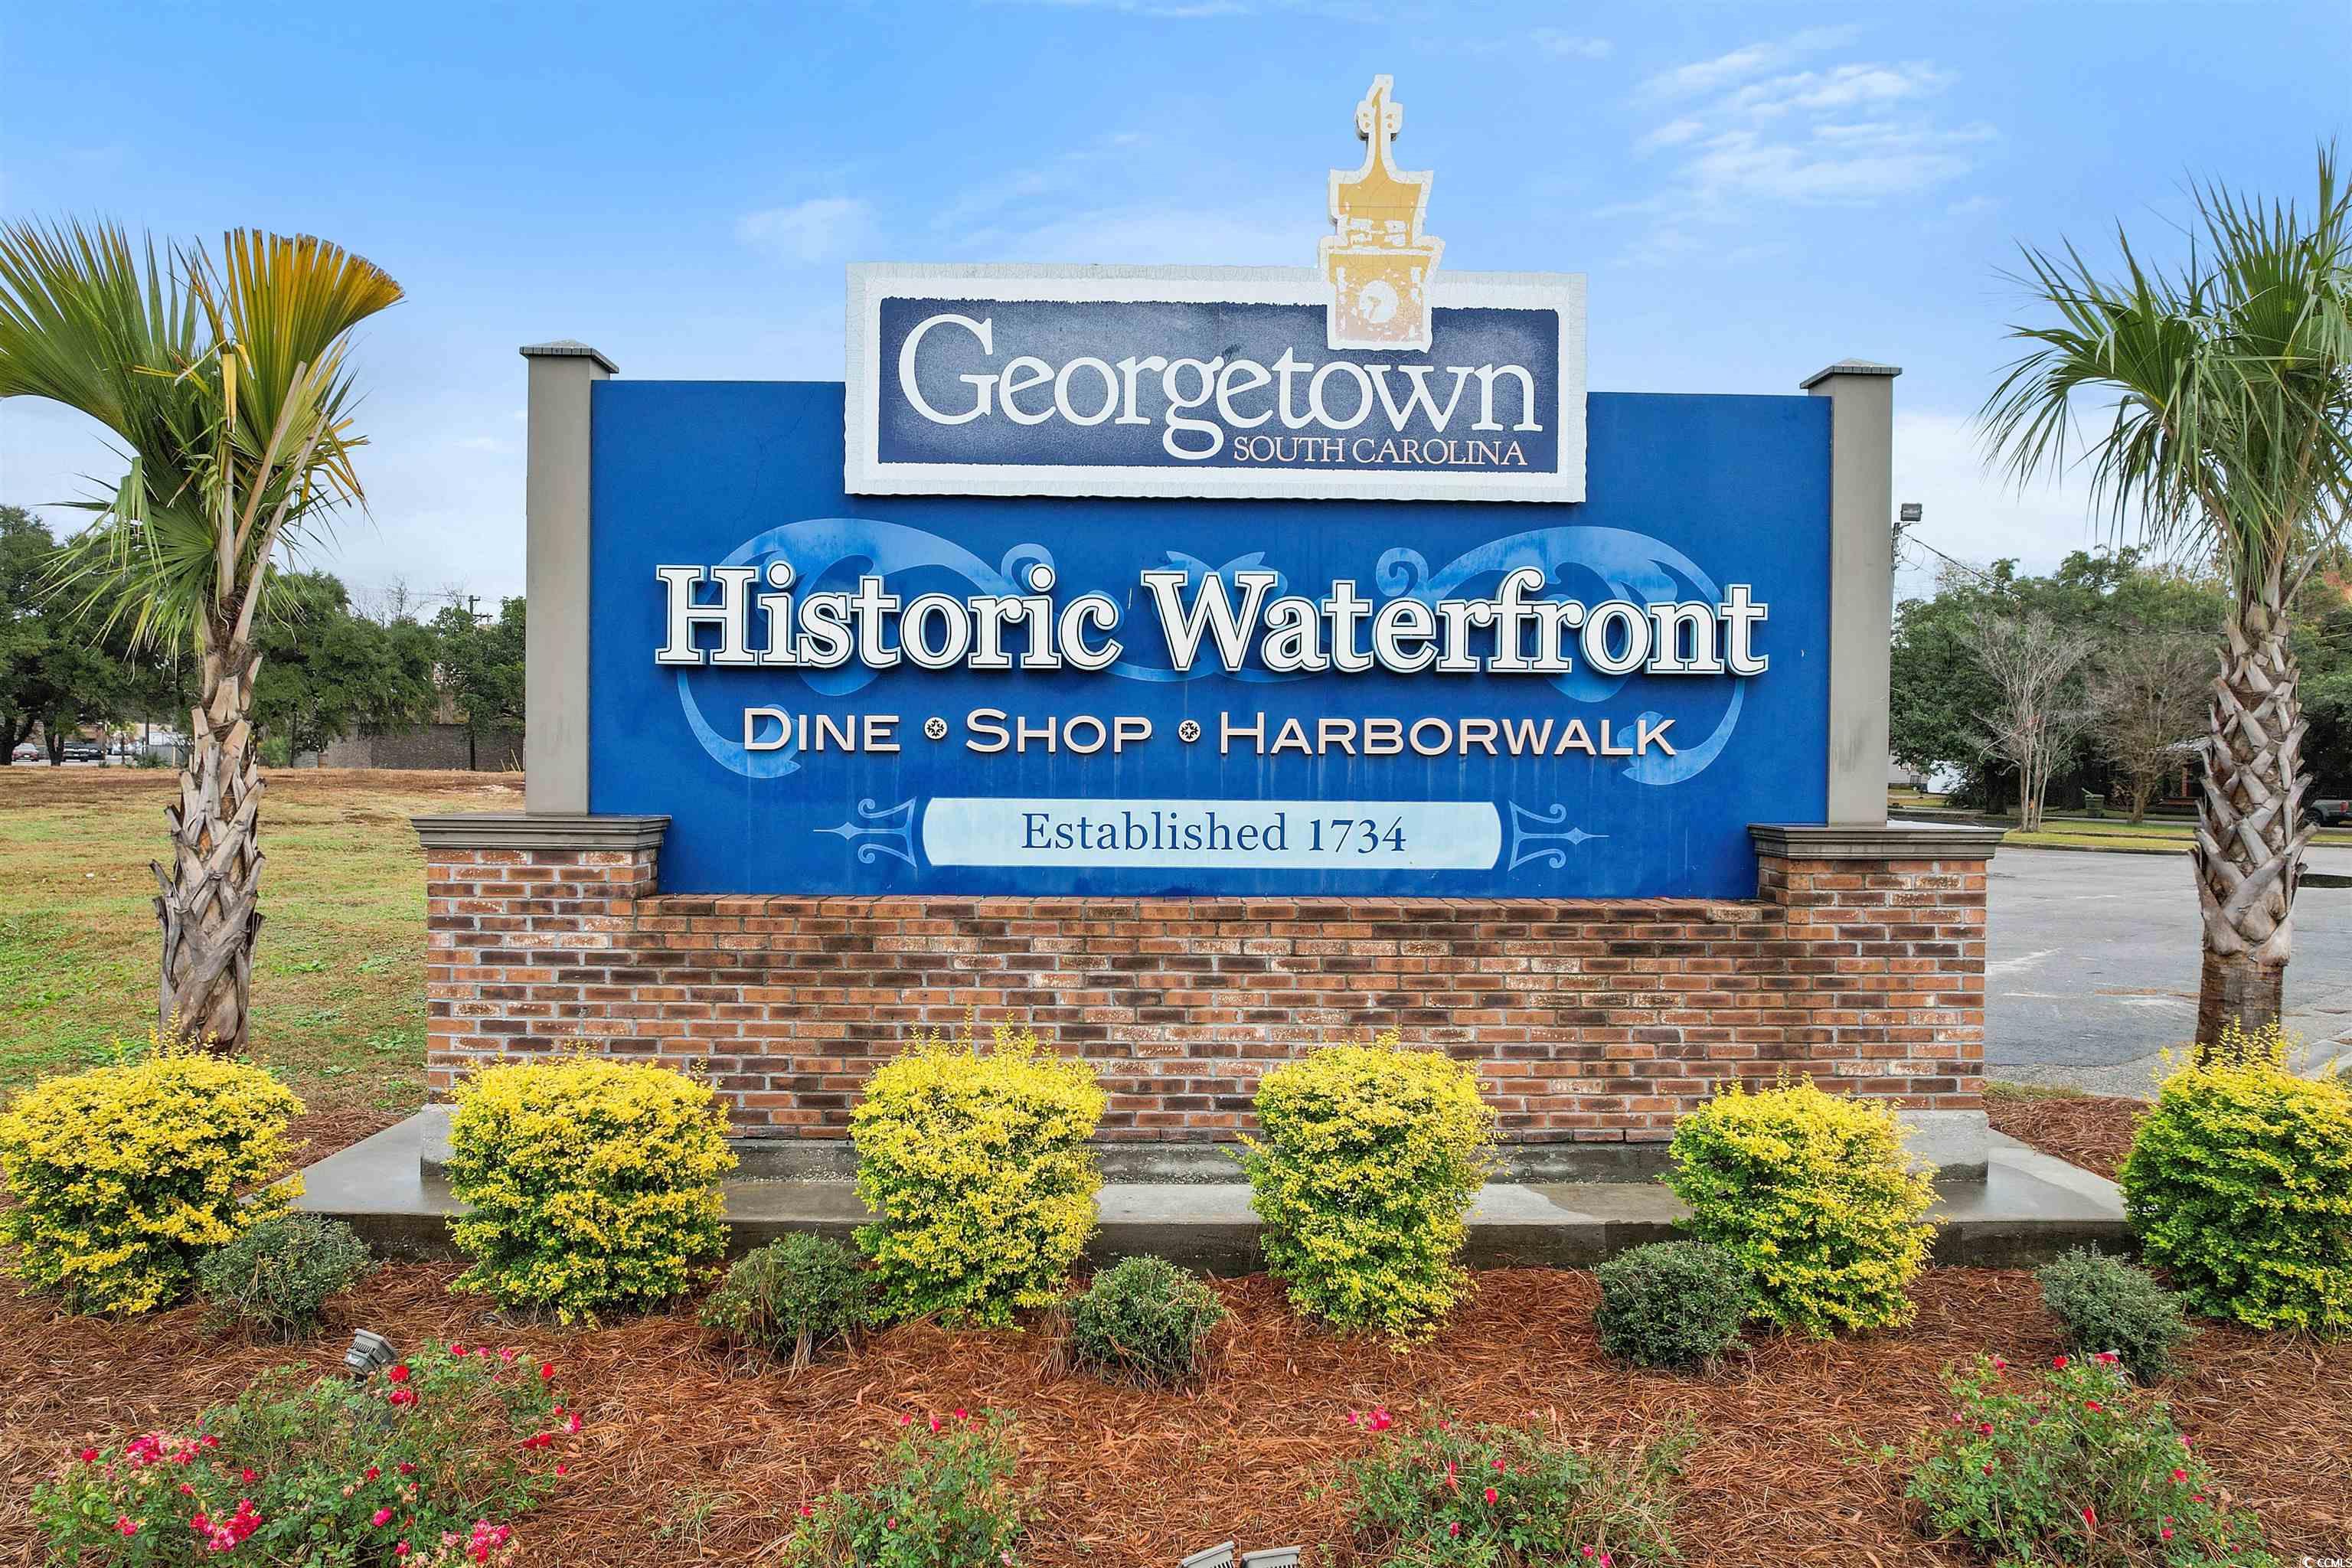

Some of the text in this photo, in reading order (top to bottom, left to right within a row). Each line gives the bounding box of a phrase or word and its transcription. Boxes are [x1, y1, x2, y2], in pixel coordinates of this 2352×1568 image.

[898, 313, 1544, 460] Georgetown
[1233, 435, 1528, 467] SOUTH CAROLINA
[655, 560, 1769, 676] Historic Waterfront
[743, 707, 1677, 756] DINE SHOP HARBORWALK
[1021, 811, 1406, 854] Established 1734
